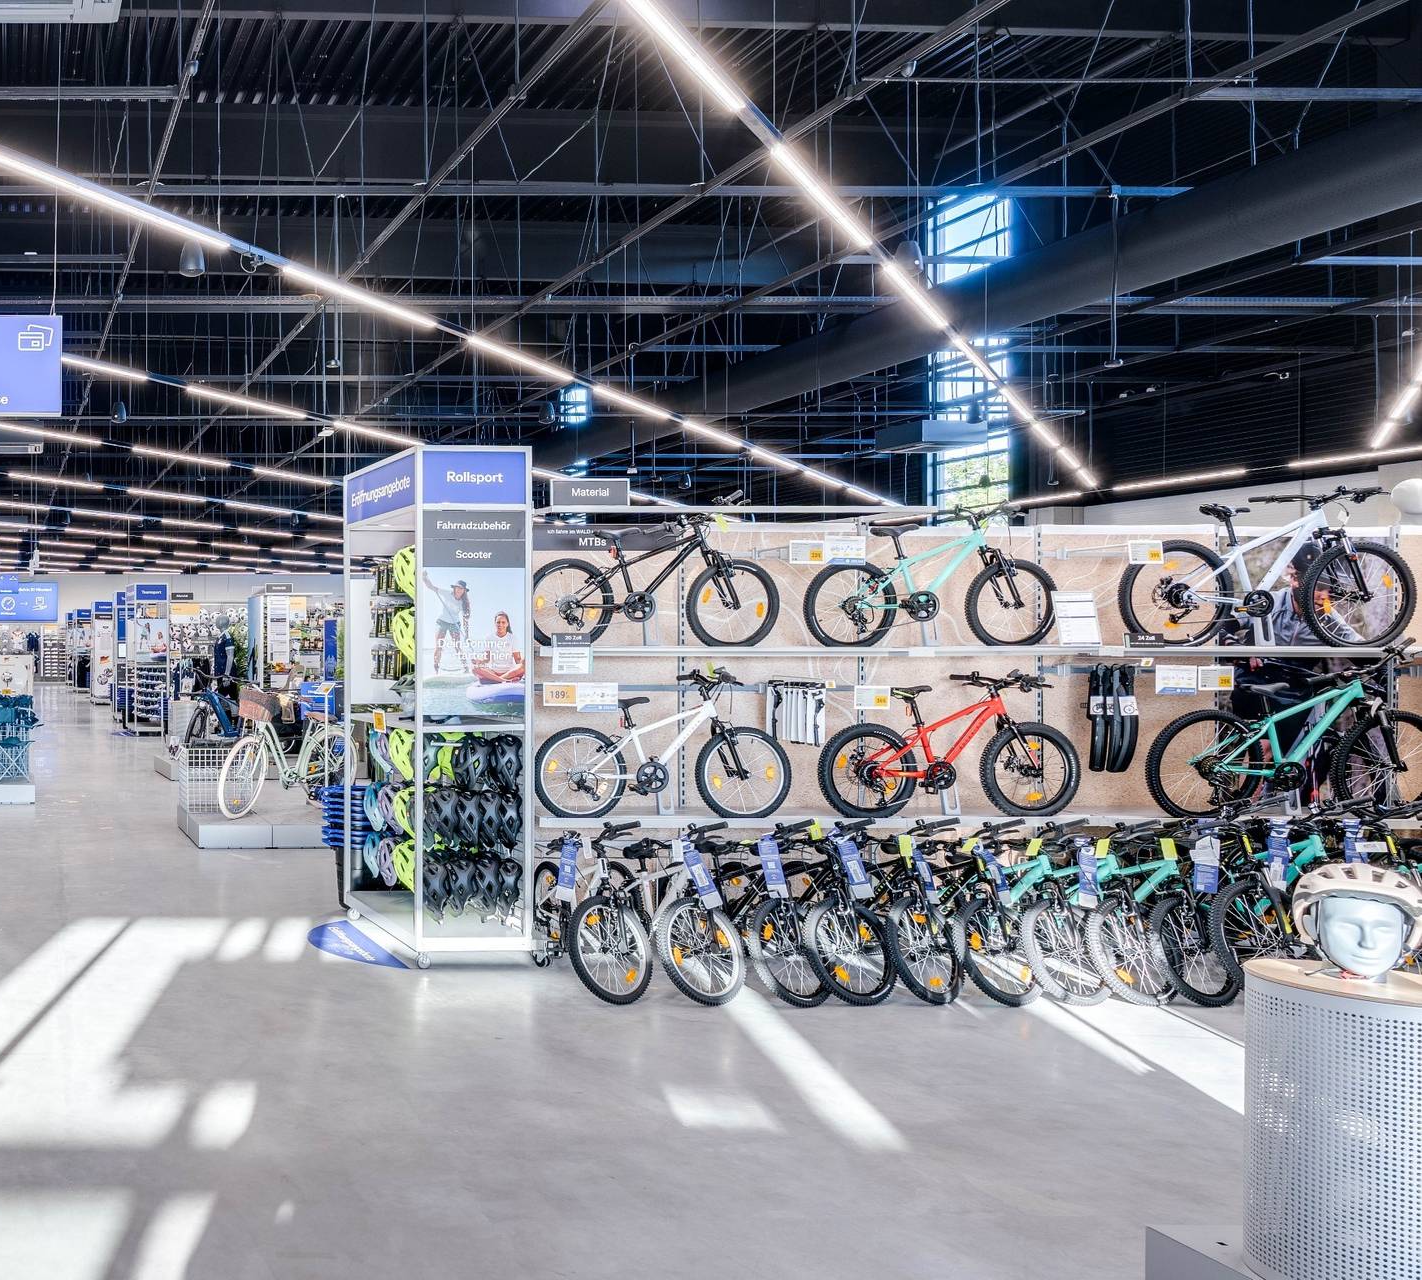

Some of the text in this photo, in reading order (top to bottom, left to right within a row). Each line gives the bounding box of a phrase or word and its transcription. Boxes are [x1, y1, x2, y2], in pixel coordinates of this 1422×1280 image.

[446, 471, 504, 485] Rollsport
[351, 475, 411, 508] Eröffnungsangebote
[571, 487, 610, 497] Material
[436, 520, 511, 531] Fahrradzubehör
[578, 537, 607, 547] MTBs
[455, 550, 493, 560] Scooter
